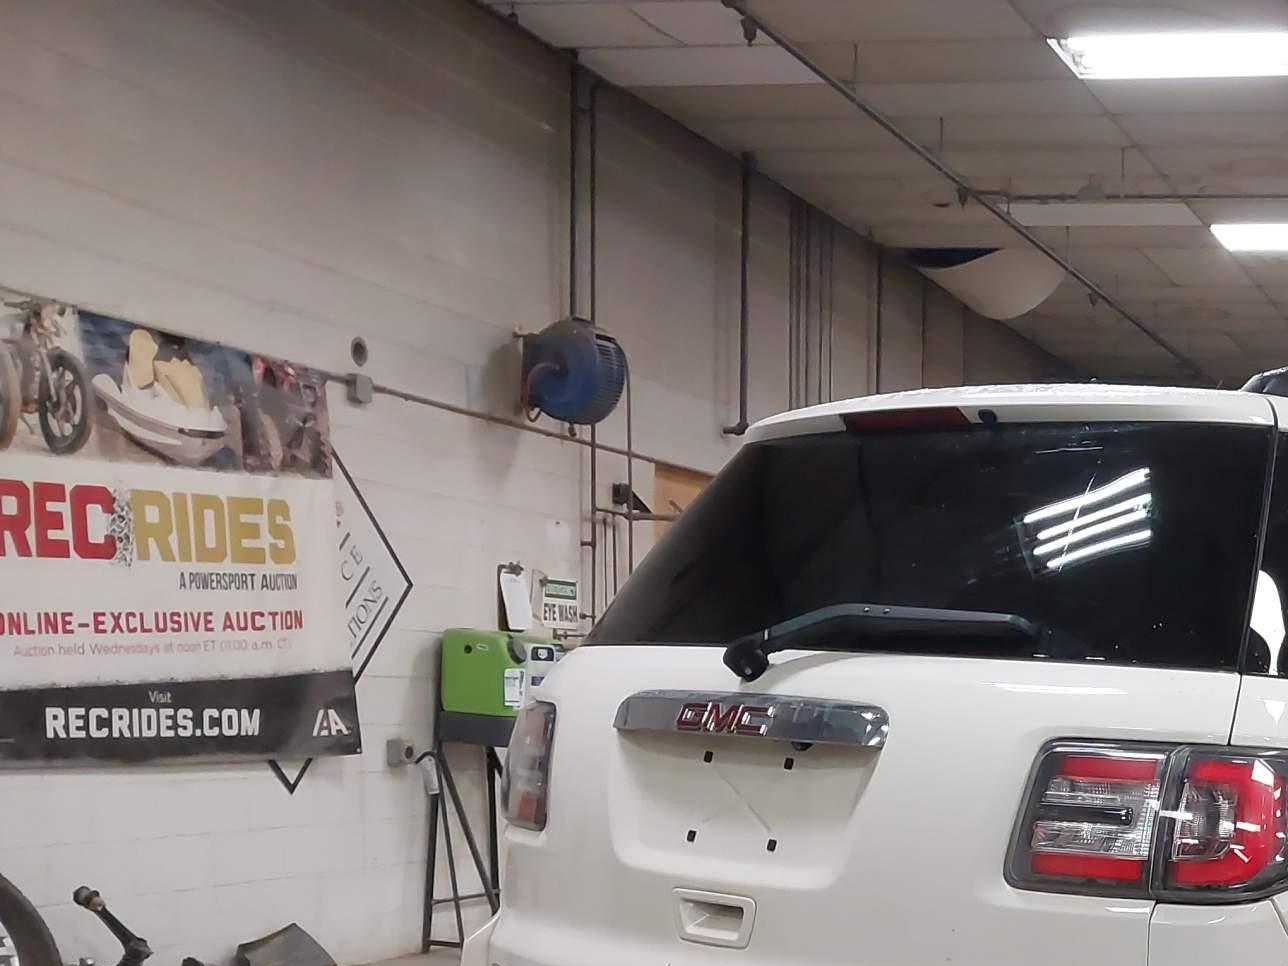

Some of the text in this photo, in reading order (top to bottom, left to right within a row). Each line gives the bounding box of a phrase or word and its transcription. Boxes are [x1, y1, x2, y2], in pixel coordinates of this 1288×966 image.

[179, 572, 298, 591] A POWERSPORT AUCTION
[544, 602, 557, 621] EYE
[222, 610, 304, 633] AUCTION
[14, 645, 55, 657] Auction
[58, 642, 85, 656] held
[89, 642, 160, 656] Wednesdays
[148, 690, 172, 704] Visit
[45, 707, 260, 738] RECRIDES.COM
[676, 701, 775, 736] GMC
